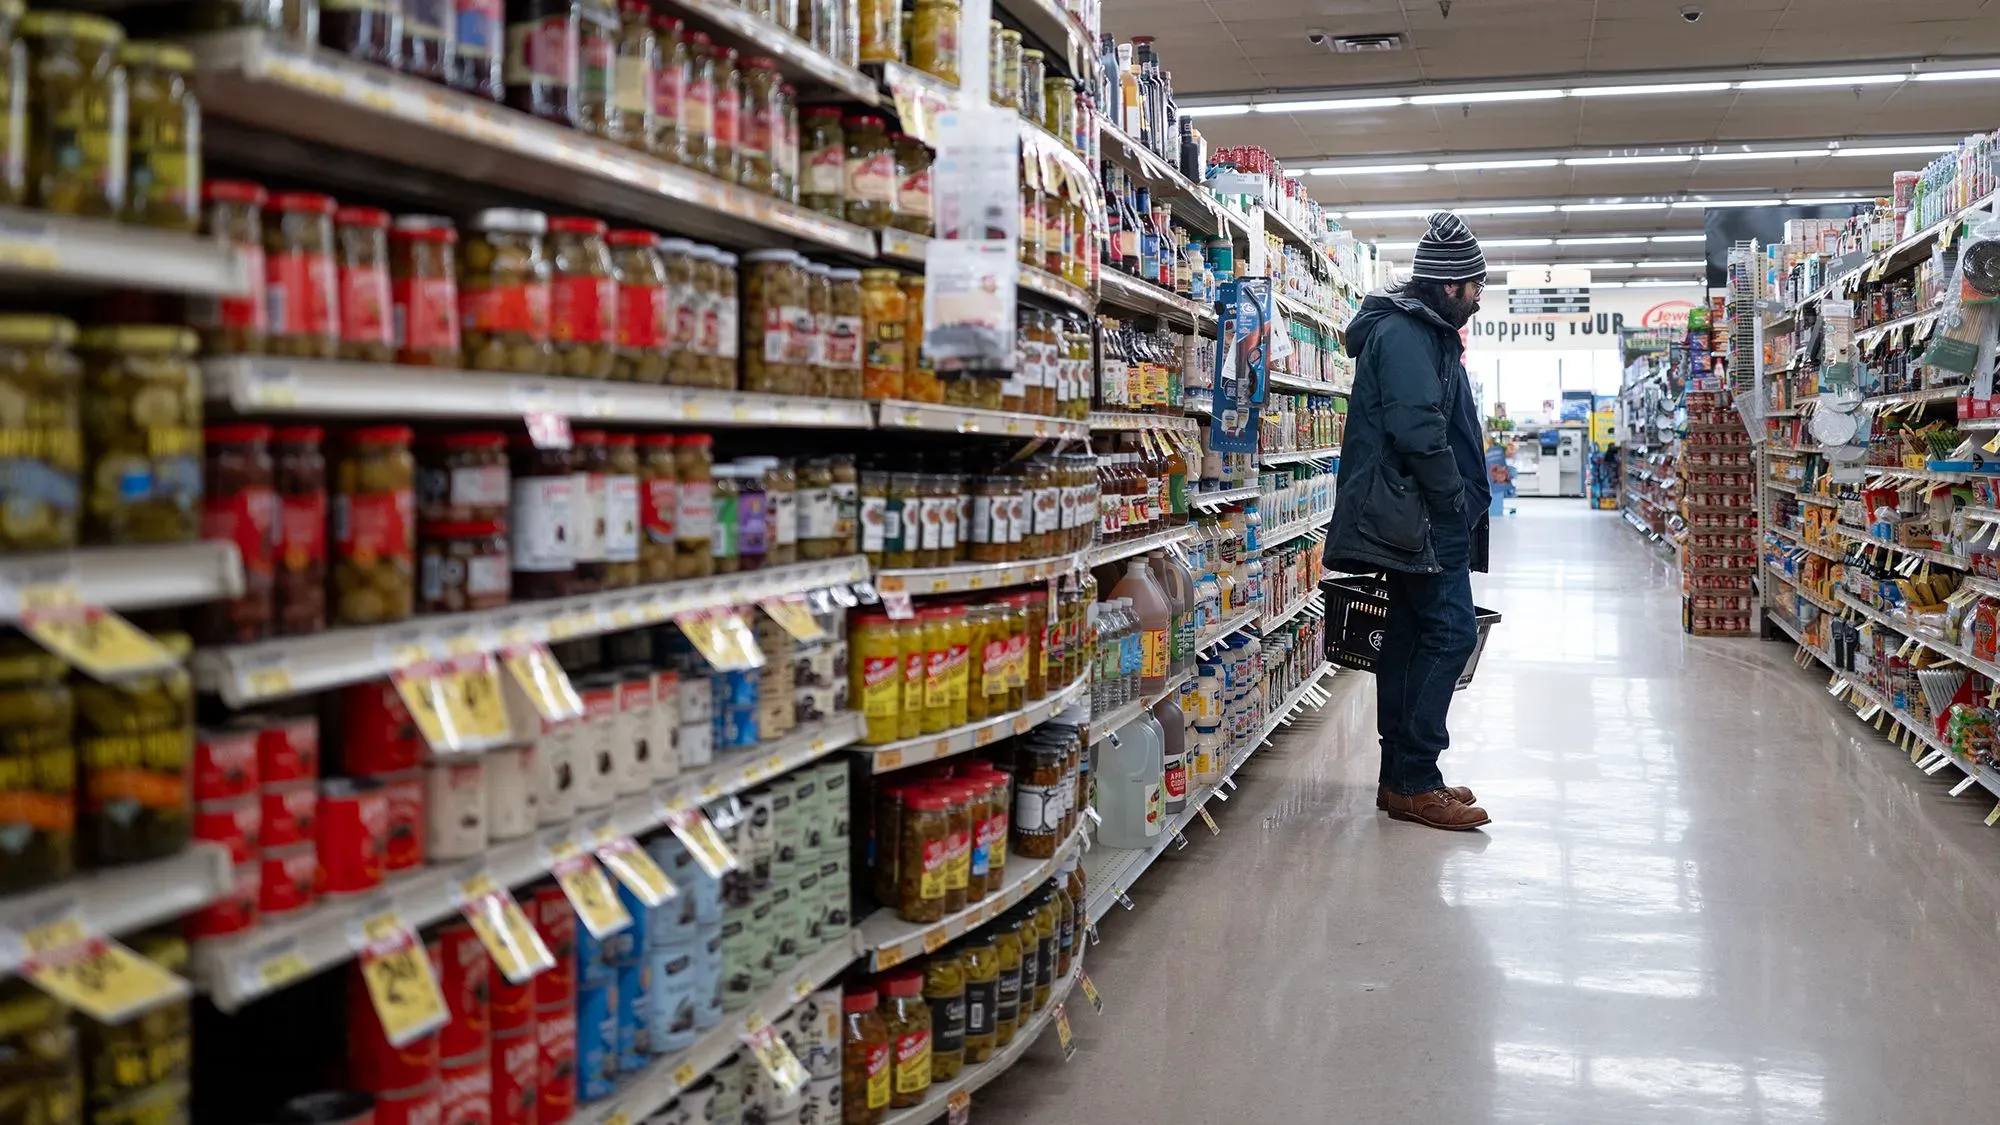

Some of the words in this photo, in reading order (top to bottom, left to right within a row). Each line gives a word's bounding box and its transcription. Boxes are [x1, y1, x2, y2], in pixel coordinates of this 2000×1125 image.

[1544, 271, 1552, 283] 3
[1652, 311, 1690, 323] Jewe
[1472, 314, 1555, 342] hopping
[1569, 313, 1624, 335] YOUR
